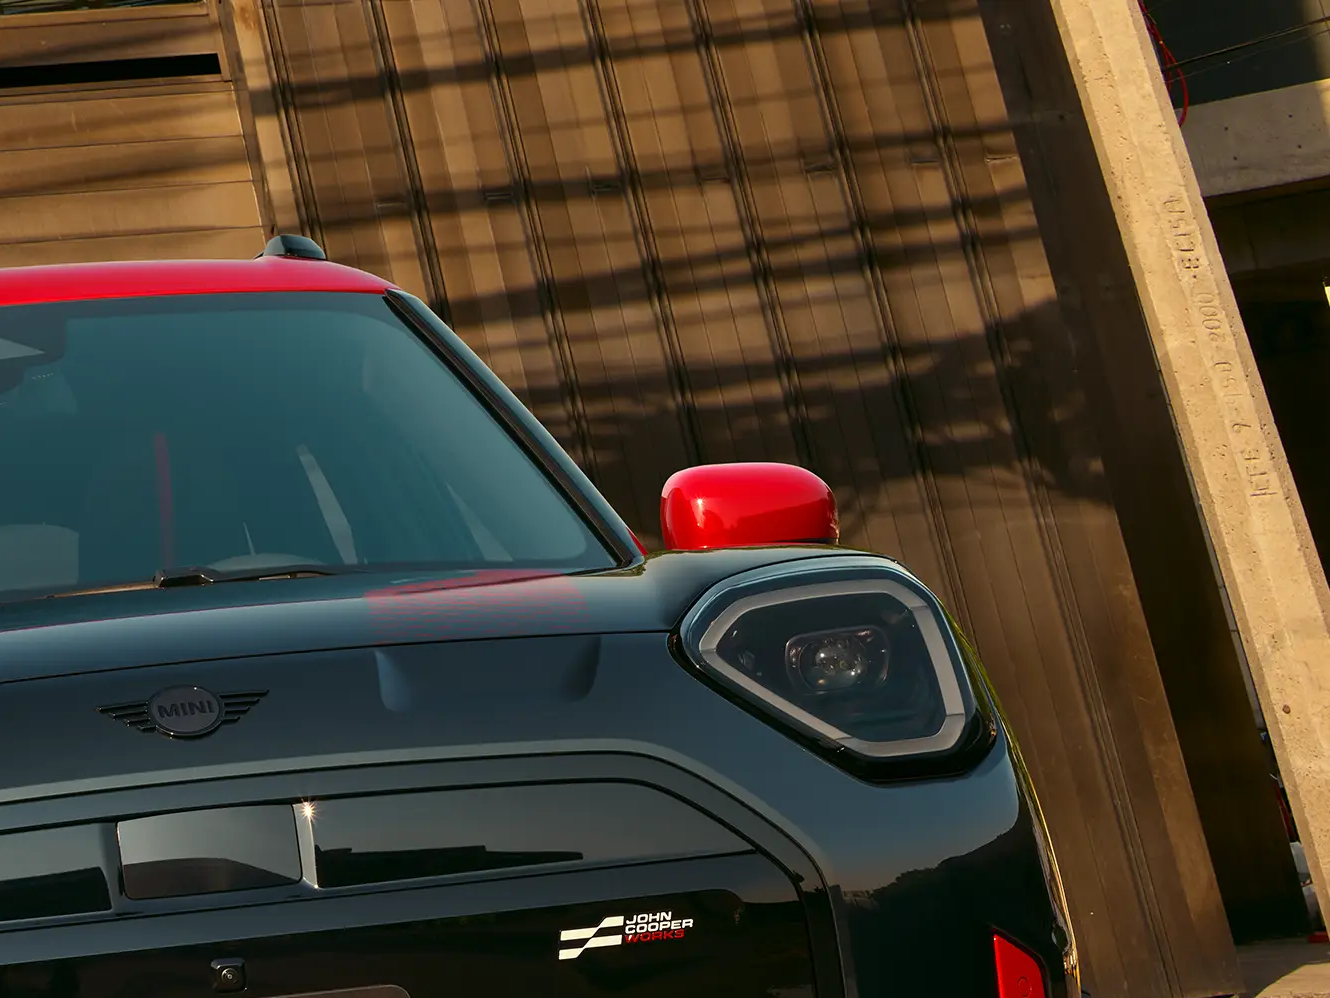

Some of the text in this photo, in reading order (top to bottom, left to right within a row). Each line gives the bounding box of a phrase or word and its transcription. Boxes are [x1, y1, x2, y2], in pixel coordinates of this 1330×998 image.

[157, 700, 215, 718] MINI
[625, 911, 672, 925] JOHN
[624, 918, 694, 935] COOPER
[624, 929, 686, 944] WORKS
